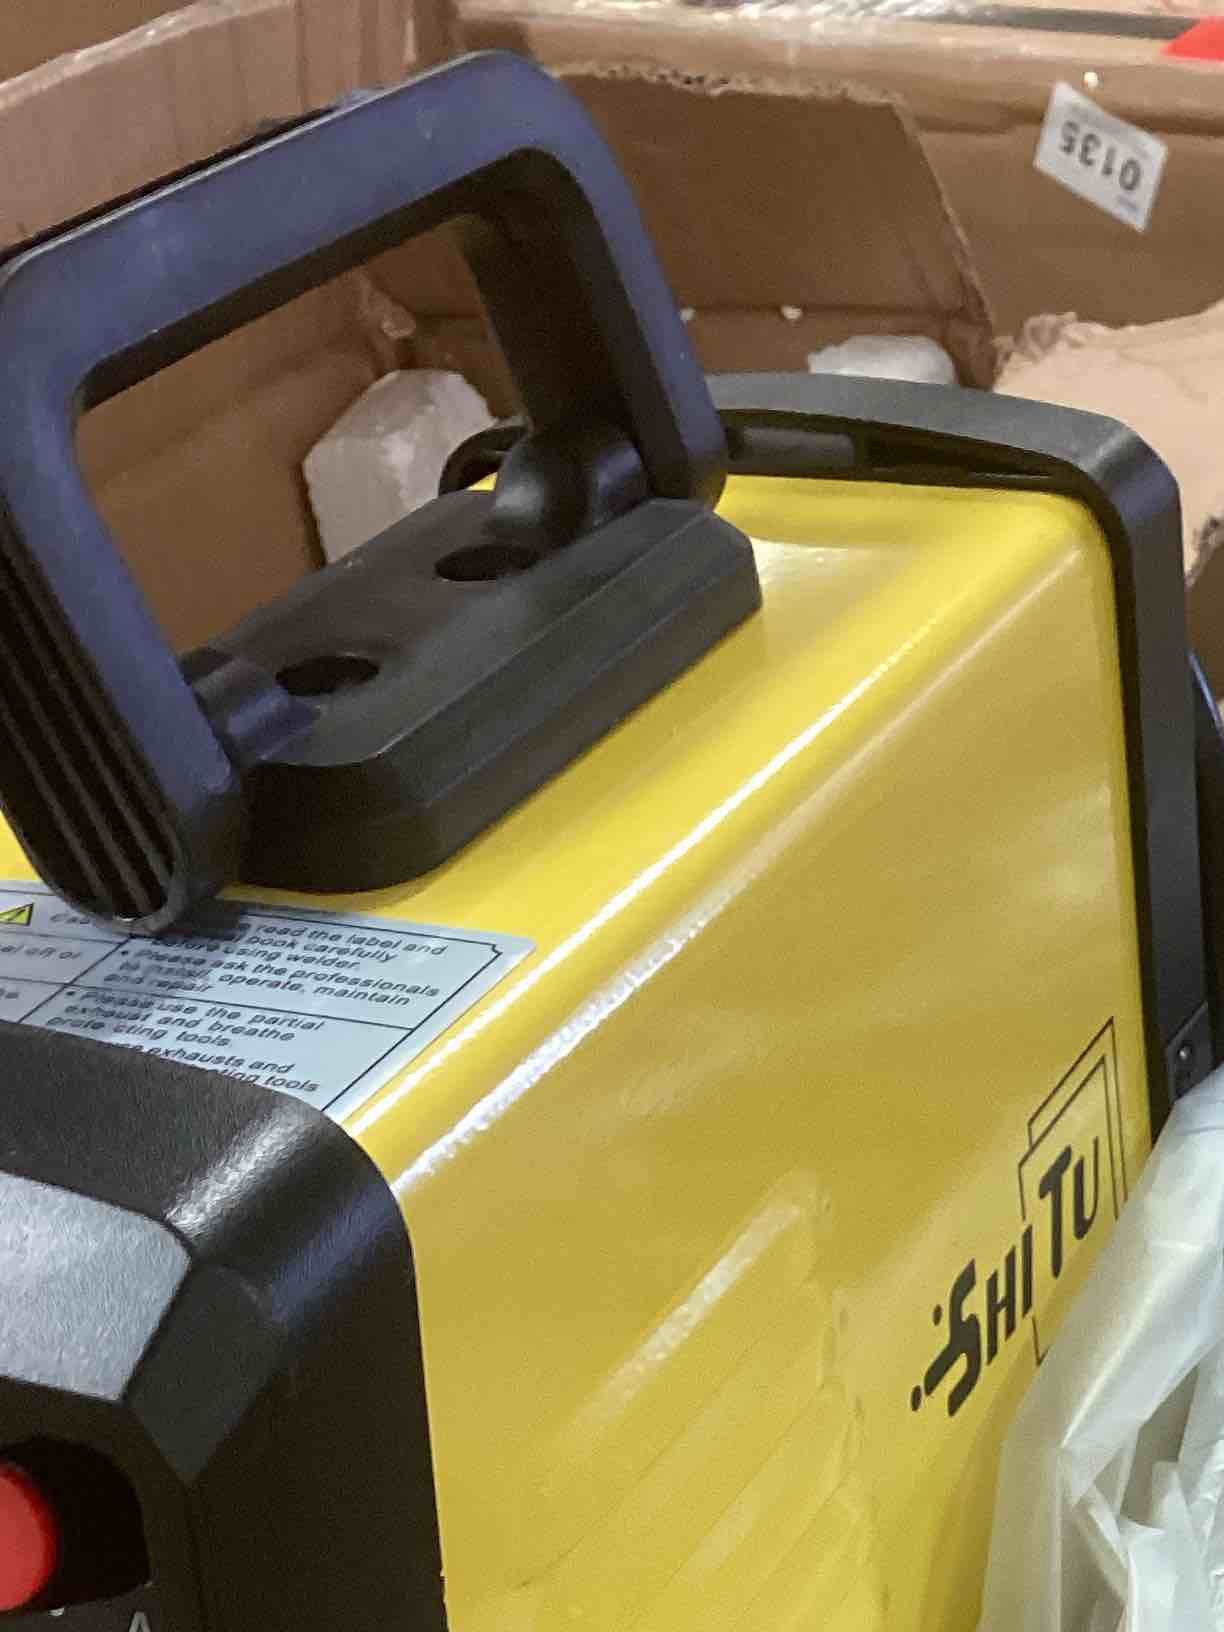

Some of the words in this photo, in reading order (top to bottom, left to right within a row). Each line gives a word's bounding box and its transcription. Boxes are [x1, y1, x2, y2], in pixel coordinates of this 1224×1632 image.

[1058, 118, 1142, 191] 0135
[303, 943, 398, 963] carefully
[308, 929, 343, 942] the
[347, 934, 402, 949] label
[402, 943, 448, 956] and
[252, 962, 288, 976] the
[289, 965, 440, 997] professionals
[312, 985, 411, 1007] maintain
[204, 1006, 242, 1020] the
[248, 1014, 326, 1032] partial
[208, 1020, 295, 1042] breathe
[248, 1060, 296, 1074] and
[263, 1075, 321, 1093] tools
